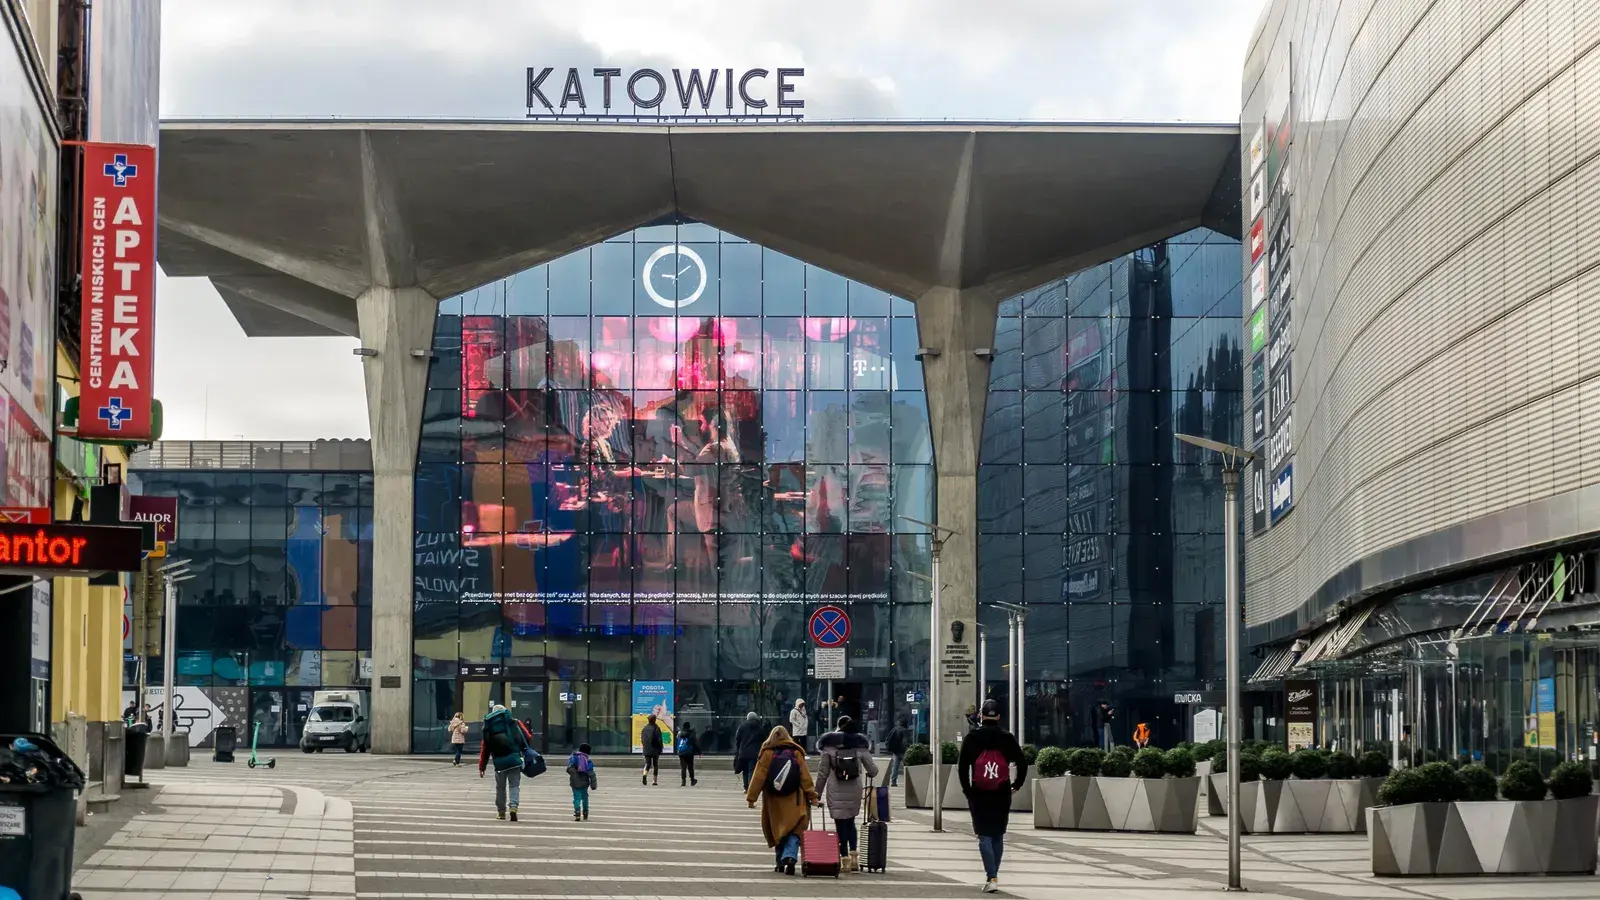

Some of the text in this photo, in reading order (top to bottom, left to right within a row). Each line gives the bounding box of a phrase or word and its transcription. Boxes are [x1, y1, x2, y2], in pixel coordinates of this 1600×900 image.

[526, 67, 805, 109] KATOWICE
[89, 197, 106, 389] CENTRUM NISKICH CEN
[109, 196, 142, 390] APTEKA
[1272, 368, 1290, 422] ZARA
[134, 512, 171, 522] ALIOR
